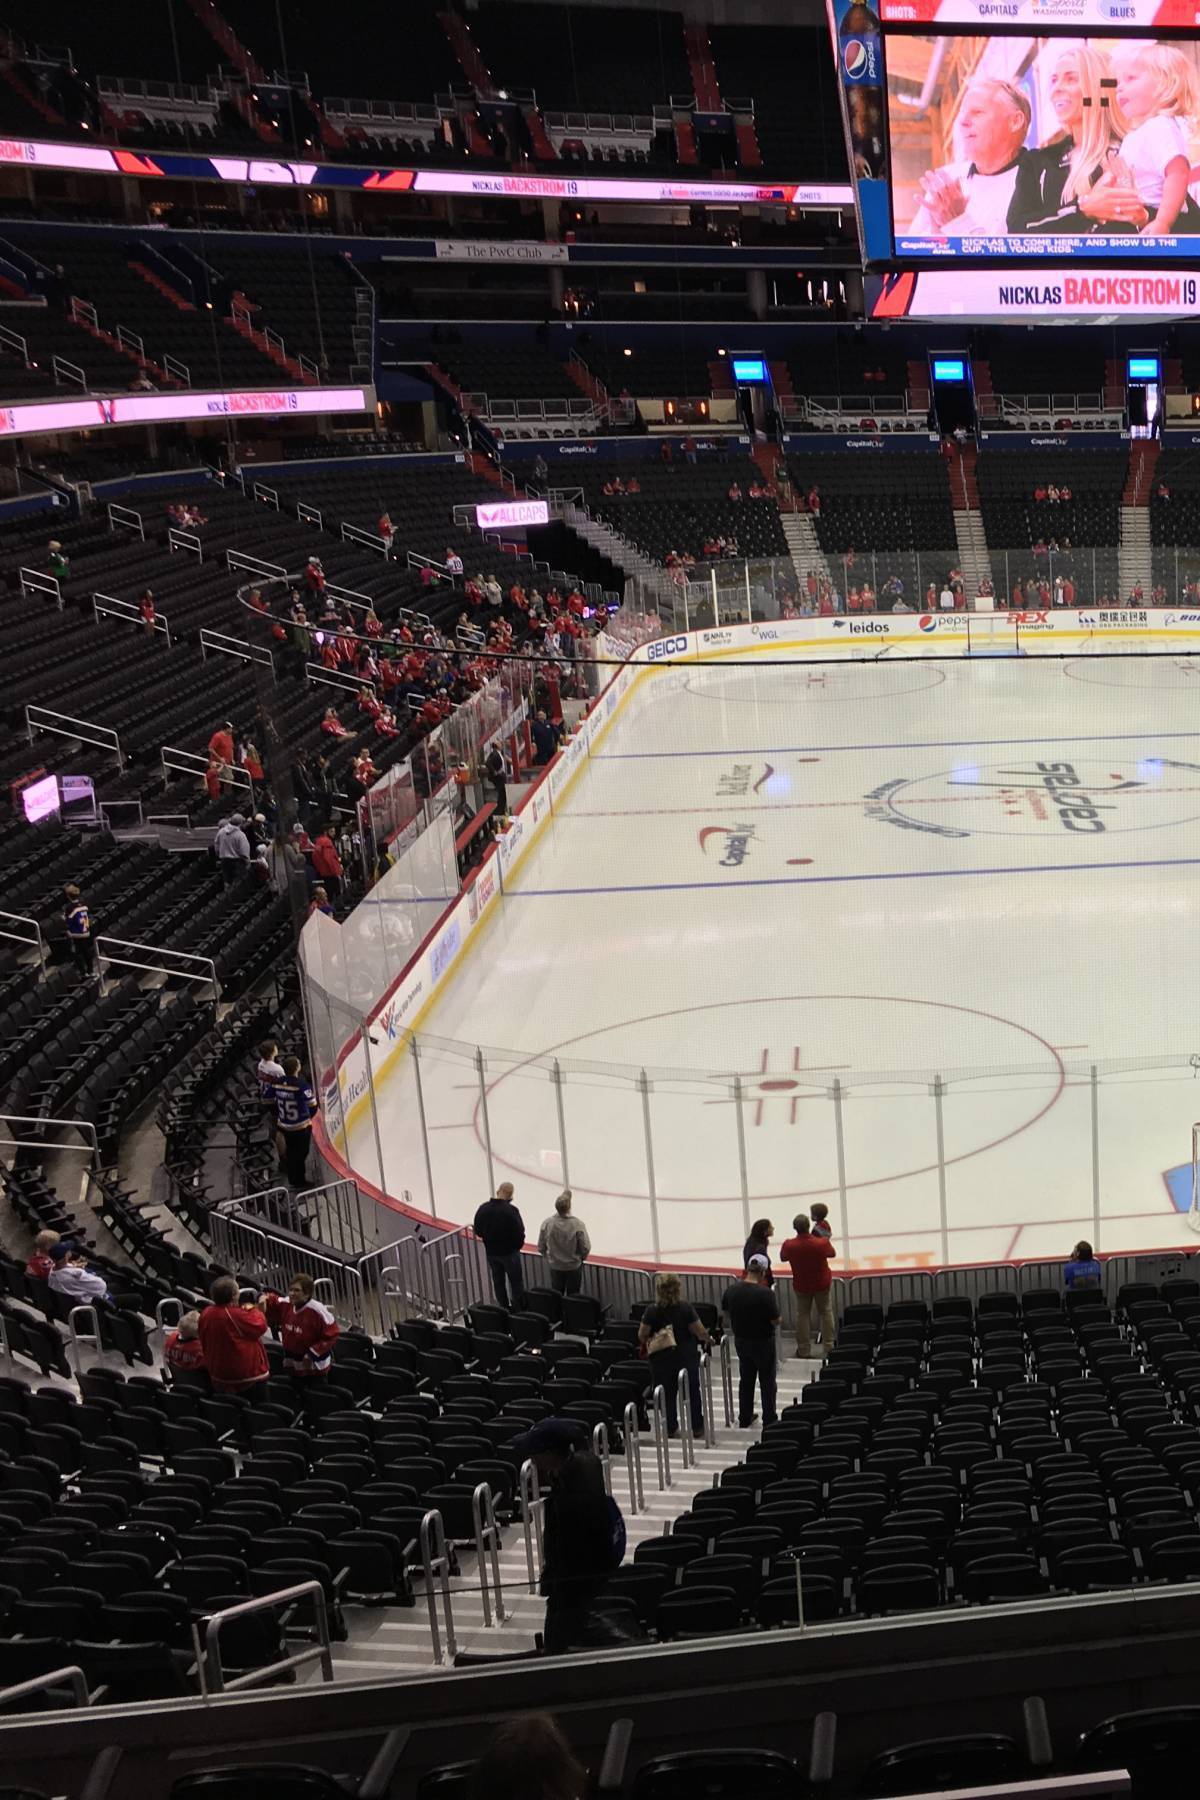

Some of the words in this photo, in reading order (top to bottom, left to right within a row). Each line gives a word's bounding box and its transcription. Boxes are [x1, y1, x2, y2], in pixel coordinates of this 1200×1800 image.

[979, 4, 1018, 15] CAPITALS
[1109, 6, 1136, 17] BLUES
[866, 41, 876, 78] pepsi
[471, 181, 503, 191] NICKLAS
[504, 176, 566, 195] BACKSTROM
[567, 181, 578, 195] 19
[962, 239, 1005, 247] NICKLAS
[1006, 239, 1020, 247] TO
[1023, 239, 1051, 247] COME
[1053, 239, 1083, 248] HERE,
[1086, 239, 1107, 247] AND
[1109, 239, 1139, 247] SHOW
[1141, 239, 1156, 247] US
[1158, 239, 1177, 247] THE
[962, 246, 985, 254] CUP,
[465, 245, 487, 257] The
[489, 246, 515, 258] PwC
[517, 247, 542, 259] Club
[999, 285, 1062, 305] NICKLAS
[1064, 277, 1181, 305] BACKSTROM
[1183, 279, 1196, 304] 19
[229, 392, 287, 412] BACKSTROM
[288, 393, 298, 409] 19
[938, 615, 969, 627] peps
[1007, 611, 1050, 624] DEX
[849, 621, 890, 634] leidos
[759, 630, 779, 640] WGL
[647, 636, 688, 661] GEICO
[277, 1099, 298, 1121] 55
